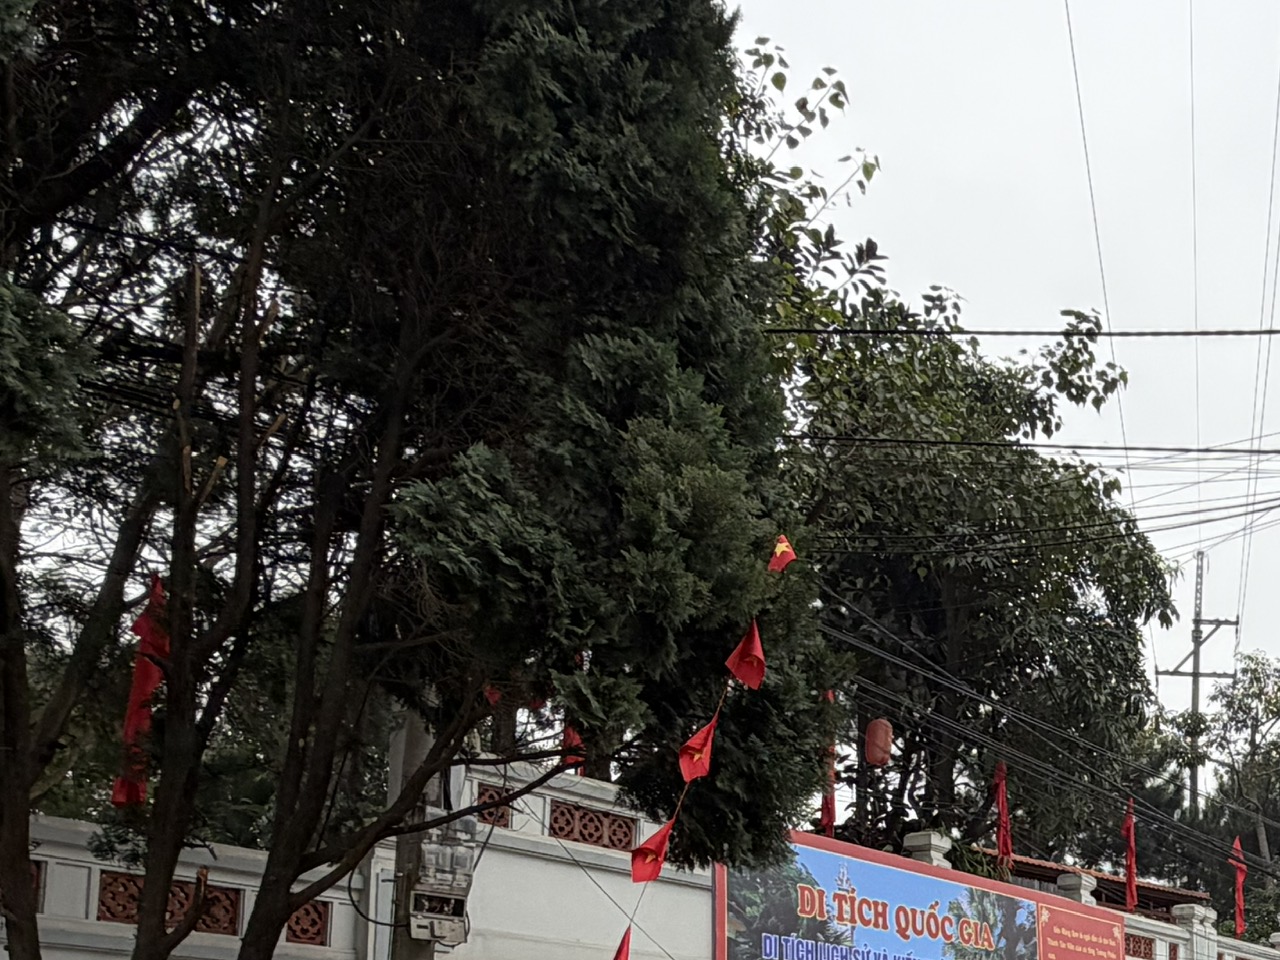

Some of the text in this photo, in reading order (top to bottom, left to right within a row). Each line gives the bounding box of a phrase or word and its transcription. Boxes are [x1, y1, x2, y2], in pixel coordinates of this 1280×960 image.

[797, 883, 995, 951] DI TÍCH QUỐC GIA
[762, 933, 779, 960] DI
